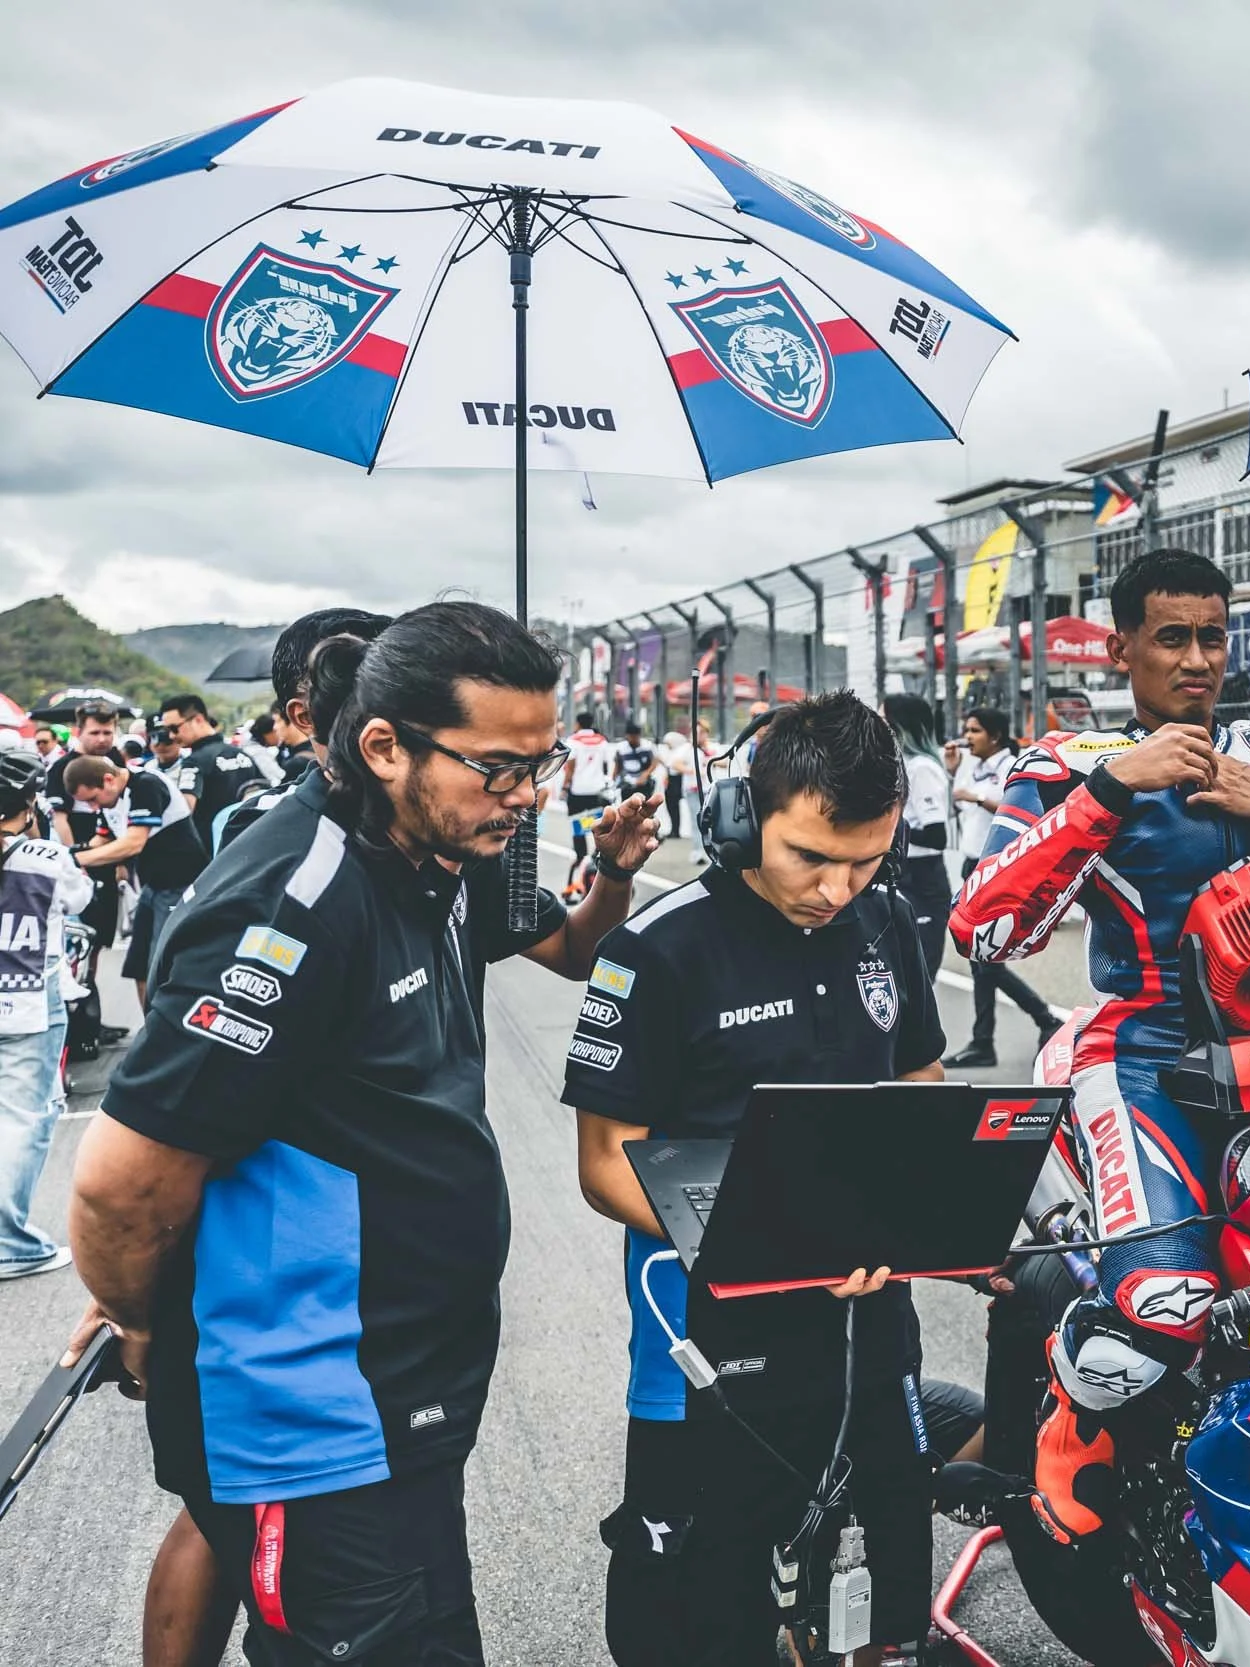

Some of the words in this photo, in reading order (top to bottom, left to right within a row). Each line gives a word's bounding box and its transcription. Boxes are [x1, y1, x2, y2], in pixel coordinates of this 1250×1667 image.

[376, 127, 601, 160] DUCATI
[22, 844, 59, 861] 072
[227, 970, 275, 1001] SHOEI
[389, 967, 428, 1003] DUCATI
[581, 1000, 613, 1023] HOEI
[719, 999, 794, 1029] DUCATI
[1015, 1115, 1050, 1124] Lenovo
[1088, 1108, 1137, 1236] DUCATI
